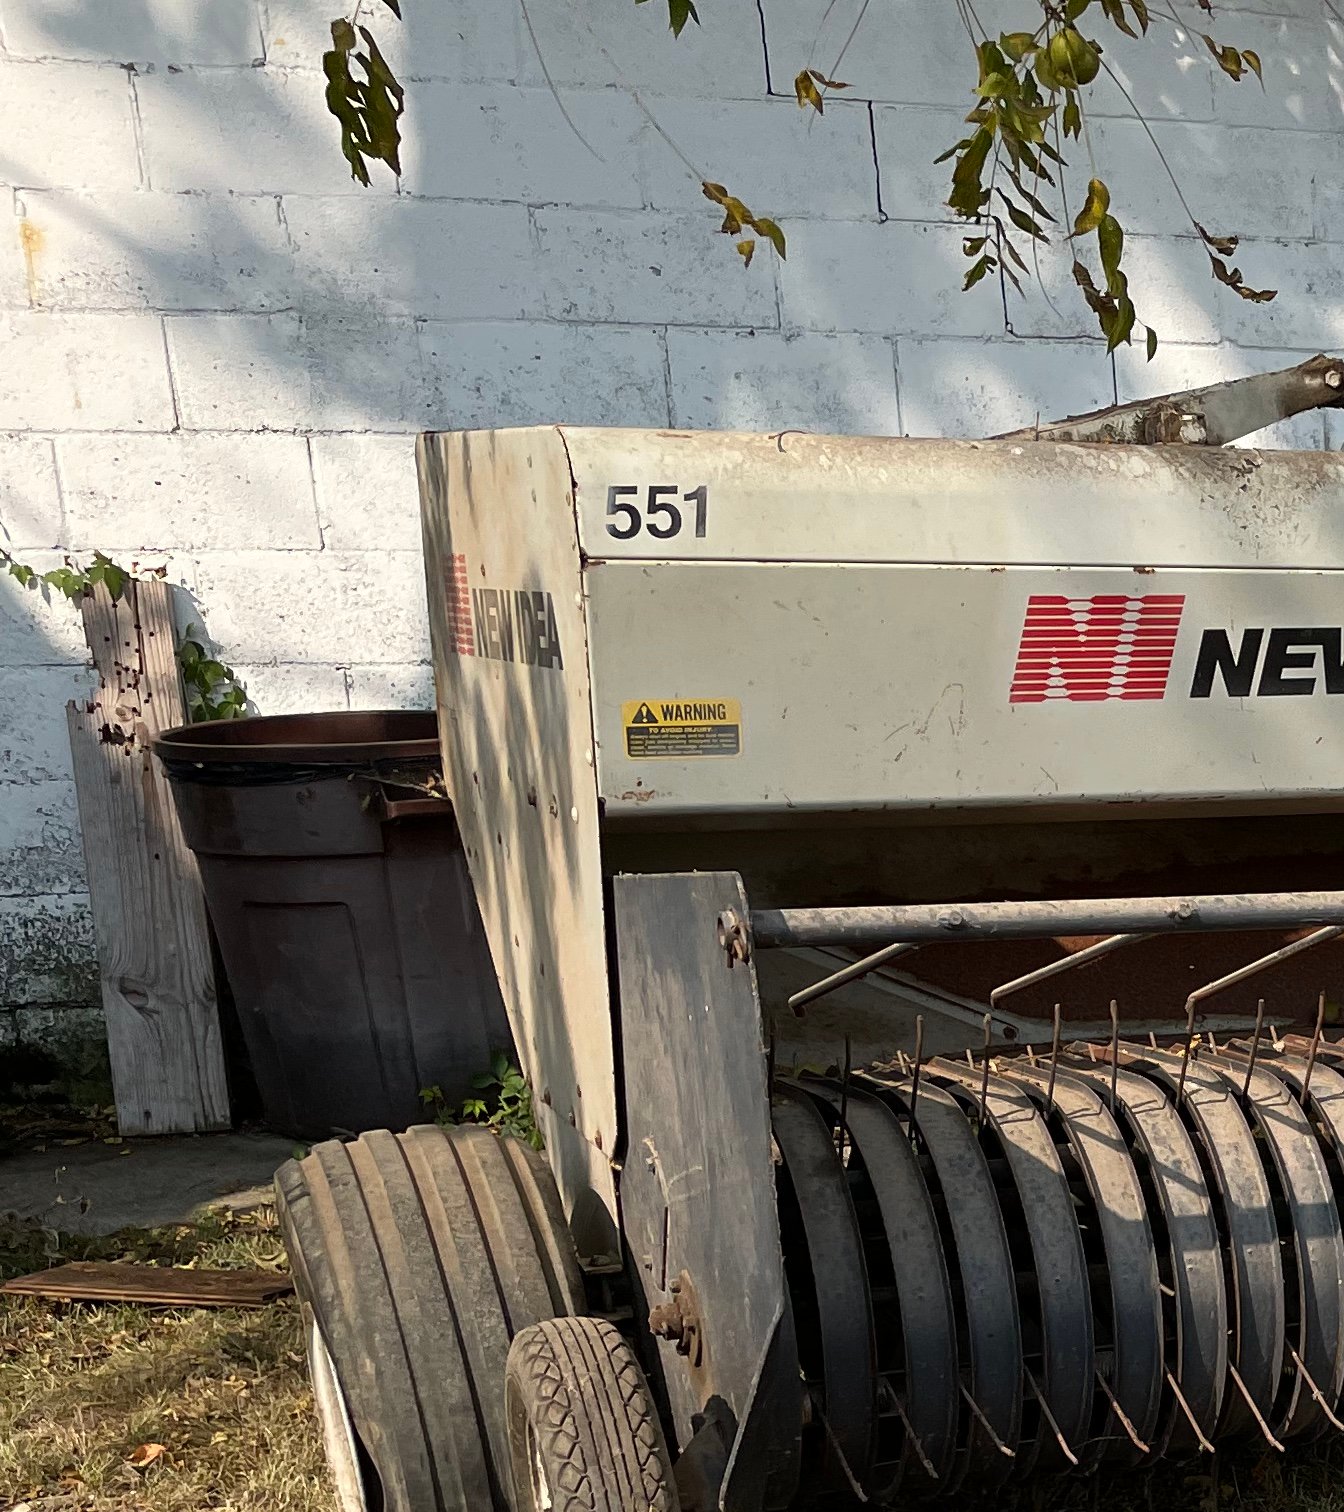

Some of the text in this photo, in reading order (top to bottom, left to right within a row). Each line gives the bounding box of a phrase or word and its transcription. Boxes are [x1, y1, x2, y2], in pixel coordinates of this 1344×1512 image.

[605, 485, 707, 540] 551
[472, 588, 515, 663] NEW
[514, 590, 564, 671] IDEA
[660, 703, 727, 722] WARNING
